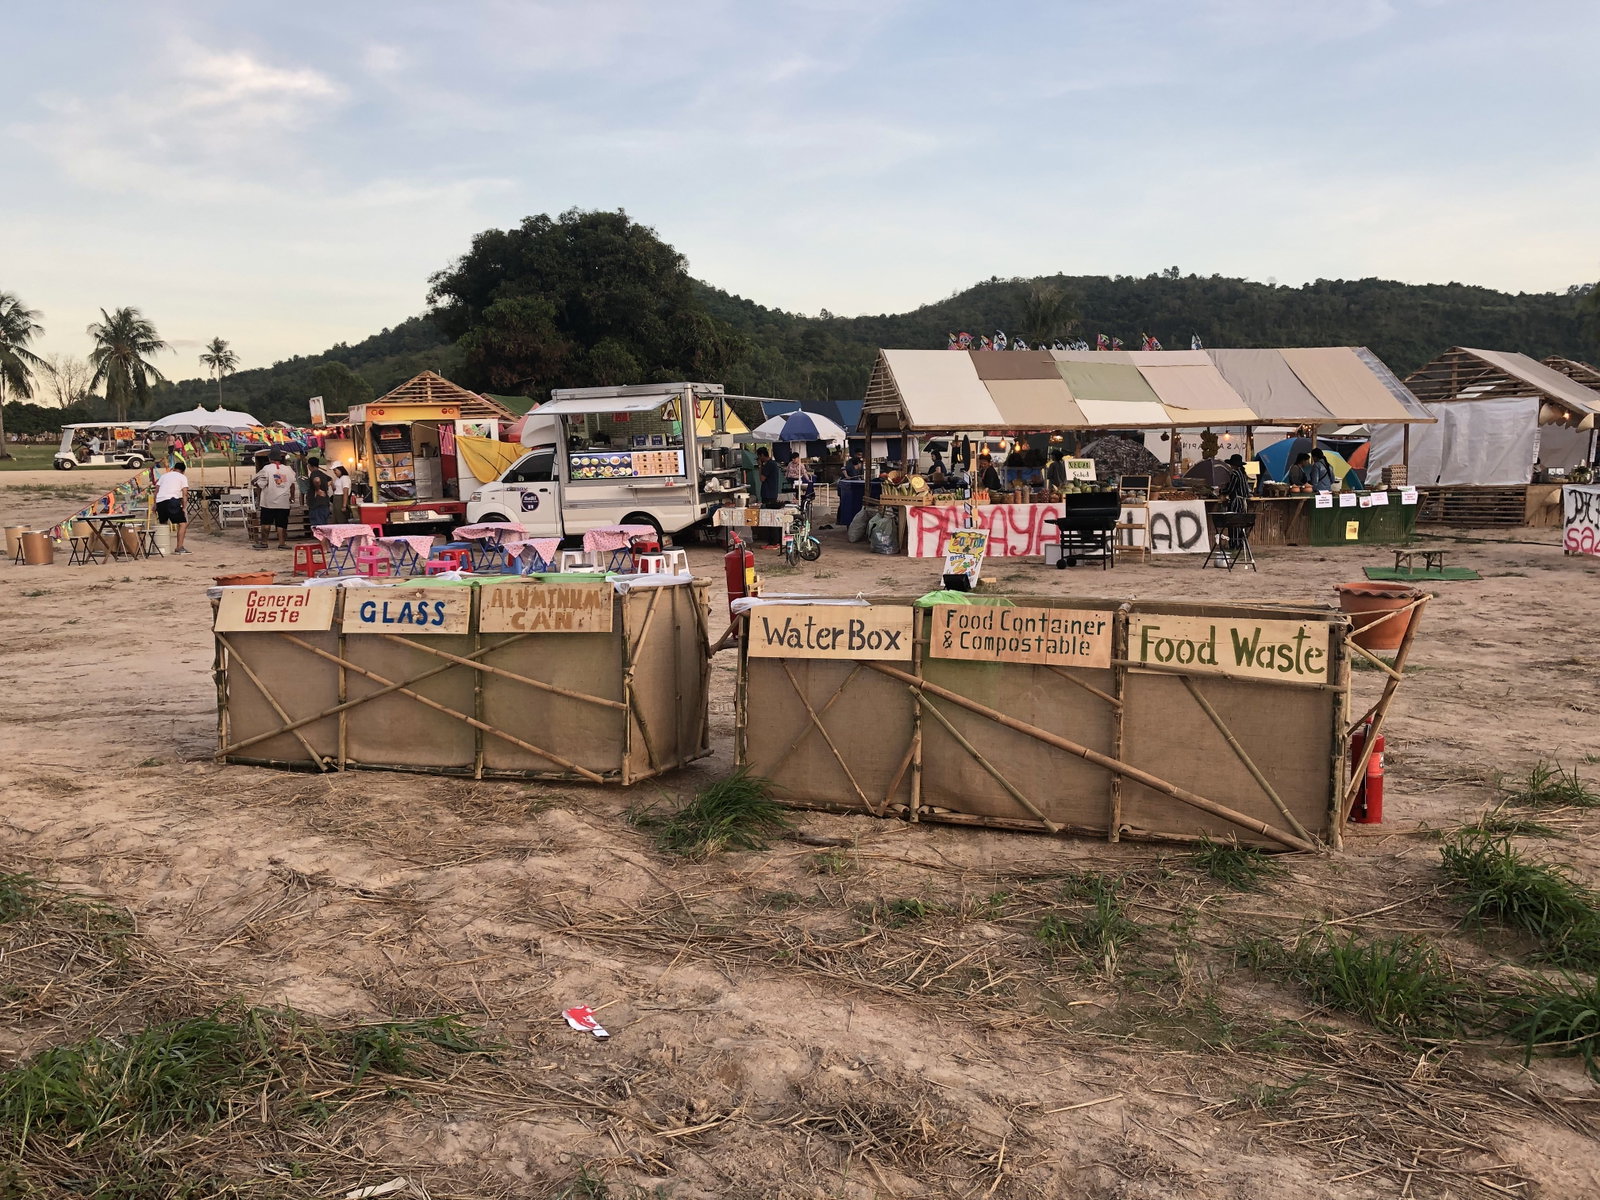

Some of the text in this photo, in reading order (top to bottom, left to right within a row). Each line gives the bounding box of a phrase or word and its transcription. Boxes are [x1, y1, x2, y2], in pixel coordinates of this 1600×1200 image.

[246, 588, 311, 607] General
[490, 588, 601, 610] ALUMINUM
[244, 607, 300, 624] Waste
[359, 601, 446, 626] GLASS
[510, 611, 573, 630] CAN
[946, 609, 1106, 636] Food Container
[942, 630, 1090, 656] & Compostable
[1140, 625, 1326, 675] Food Waste
